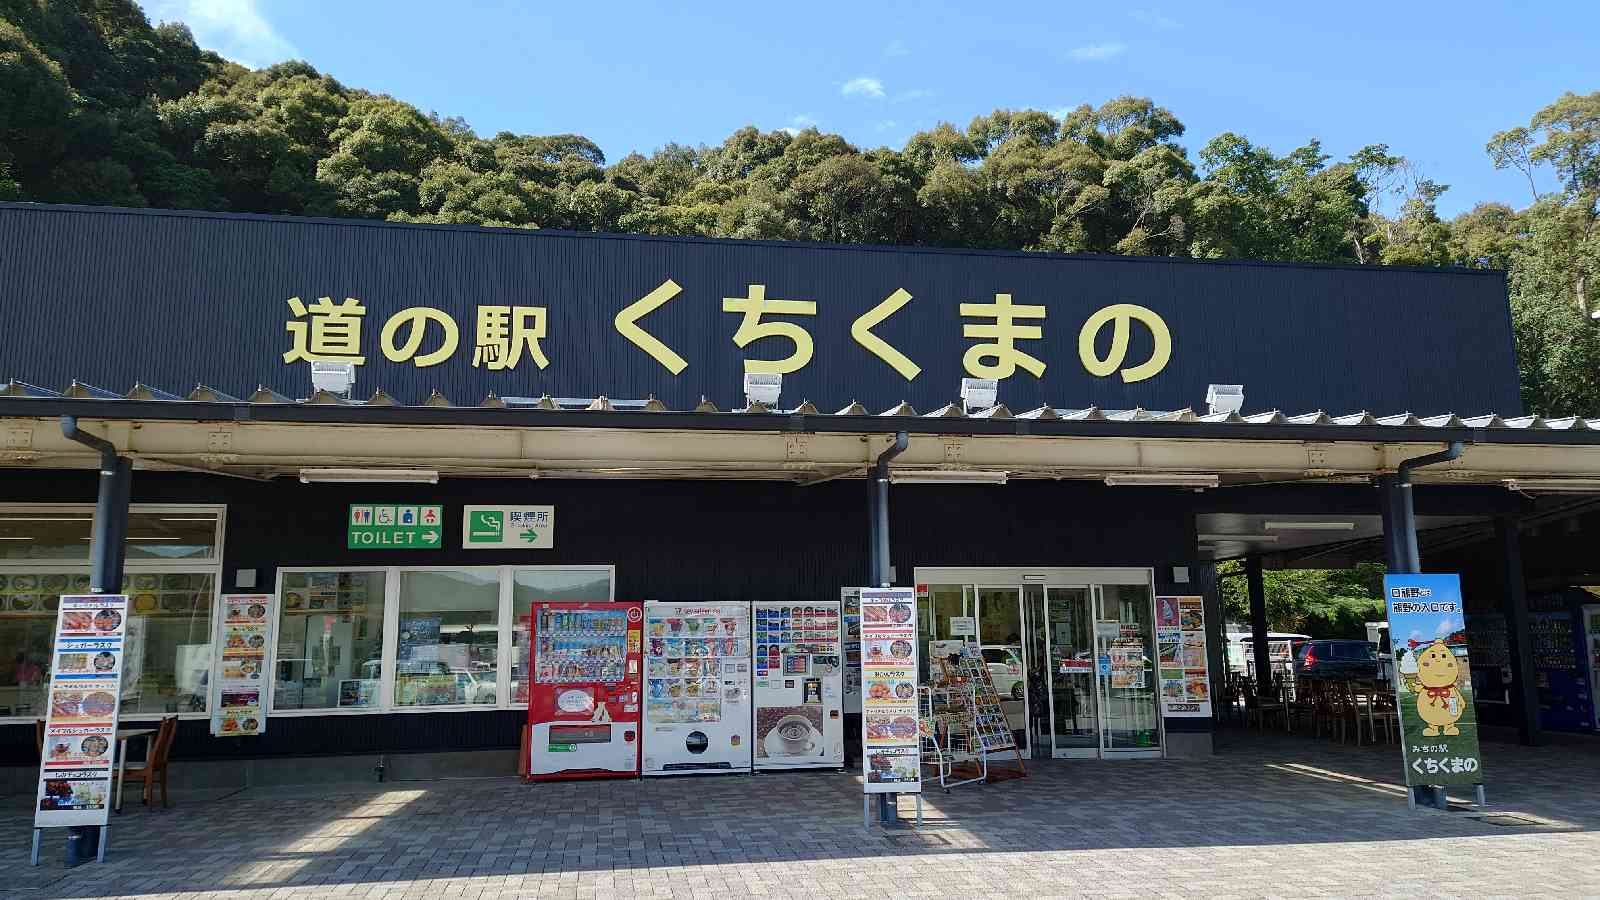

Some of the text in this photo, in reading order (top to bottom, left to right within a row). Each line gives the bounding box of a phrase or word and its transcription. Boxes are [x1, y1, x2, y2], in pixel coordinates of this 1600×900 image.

[283, 278, 1172, 383] 道の駅 くちくまの
[511, 511, 549, 522] 喫煙所
[351, 531, 416, 544] TOILET
[1411, 743, 1449, 753] みちの駅
[1411, 757, 1479, 775] くちくまの
